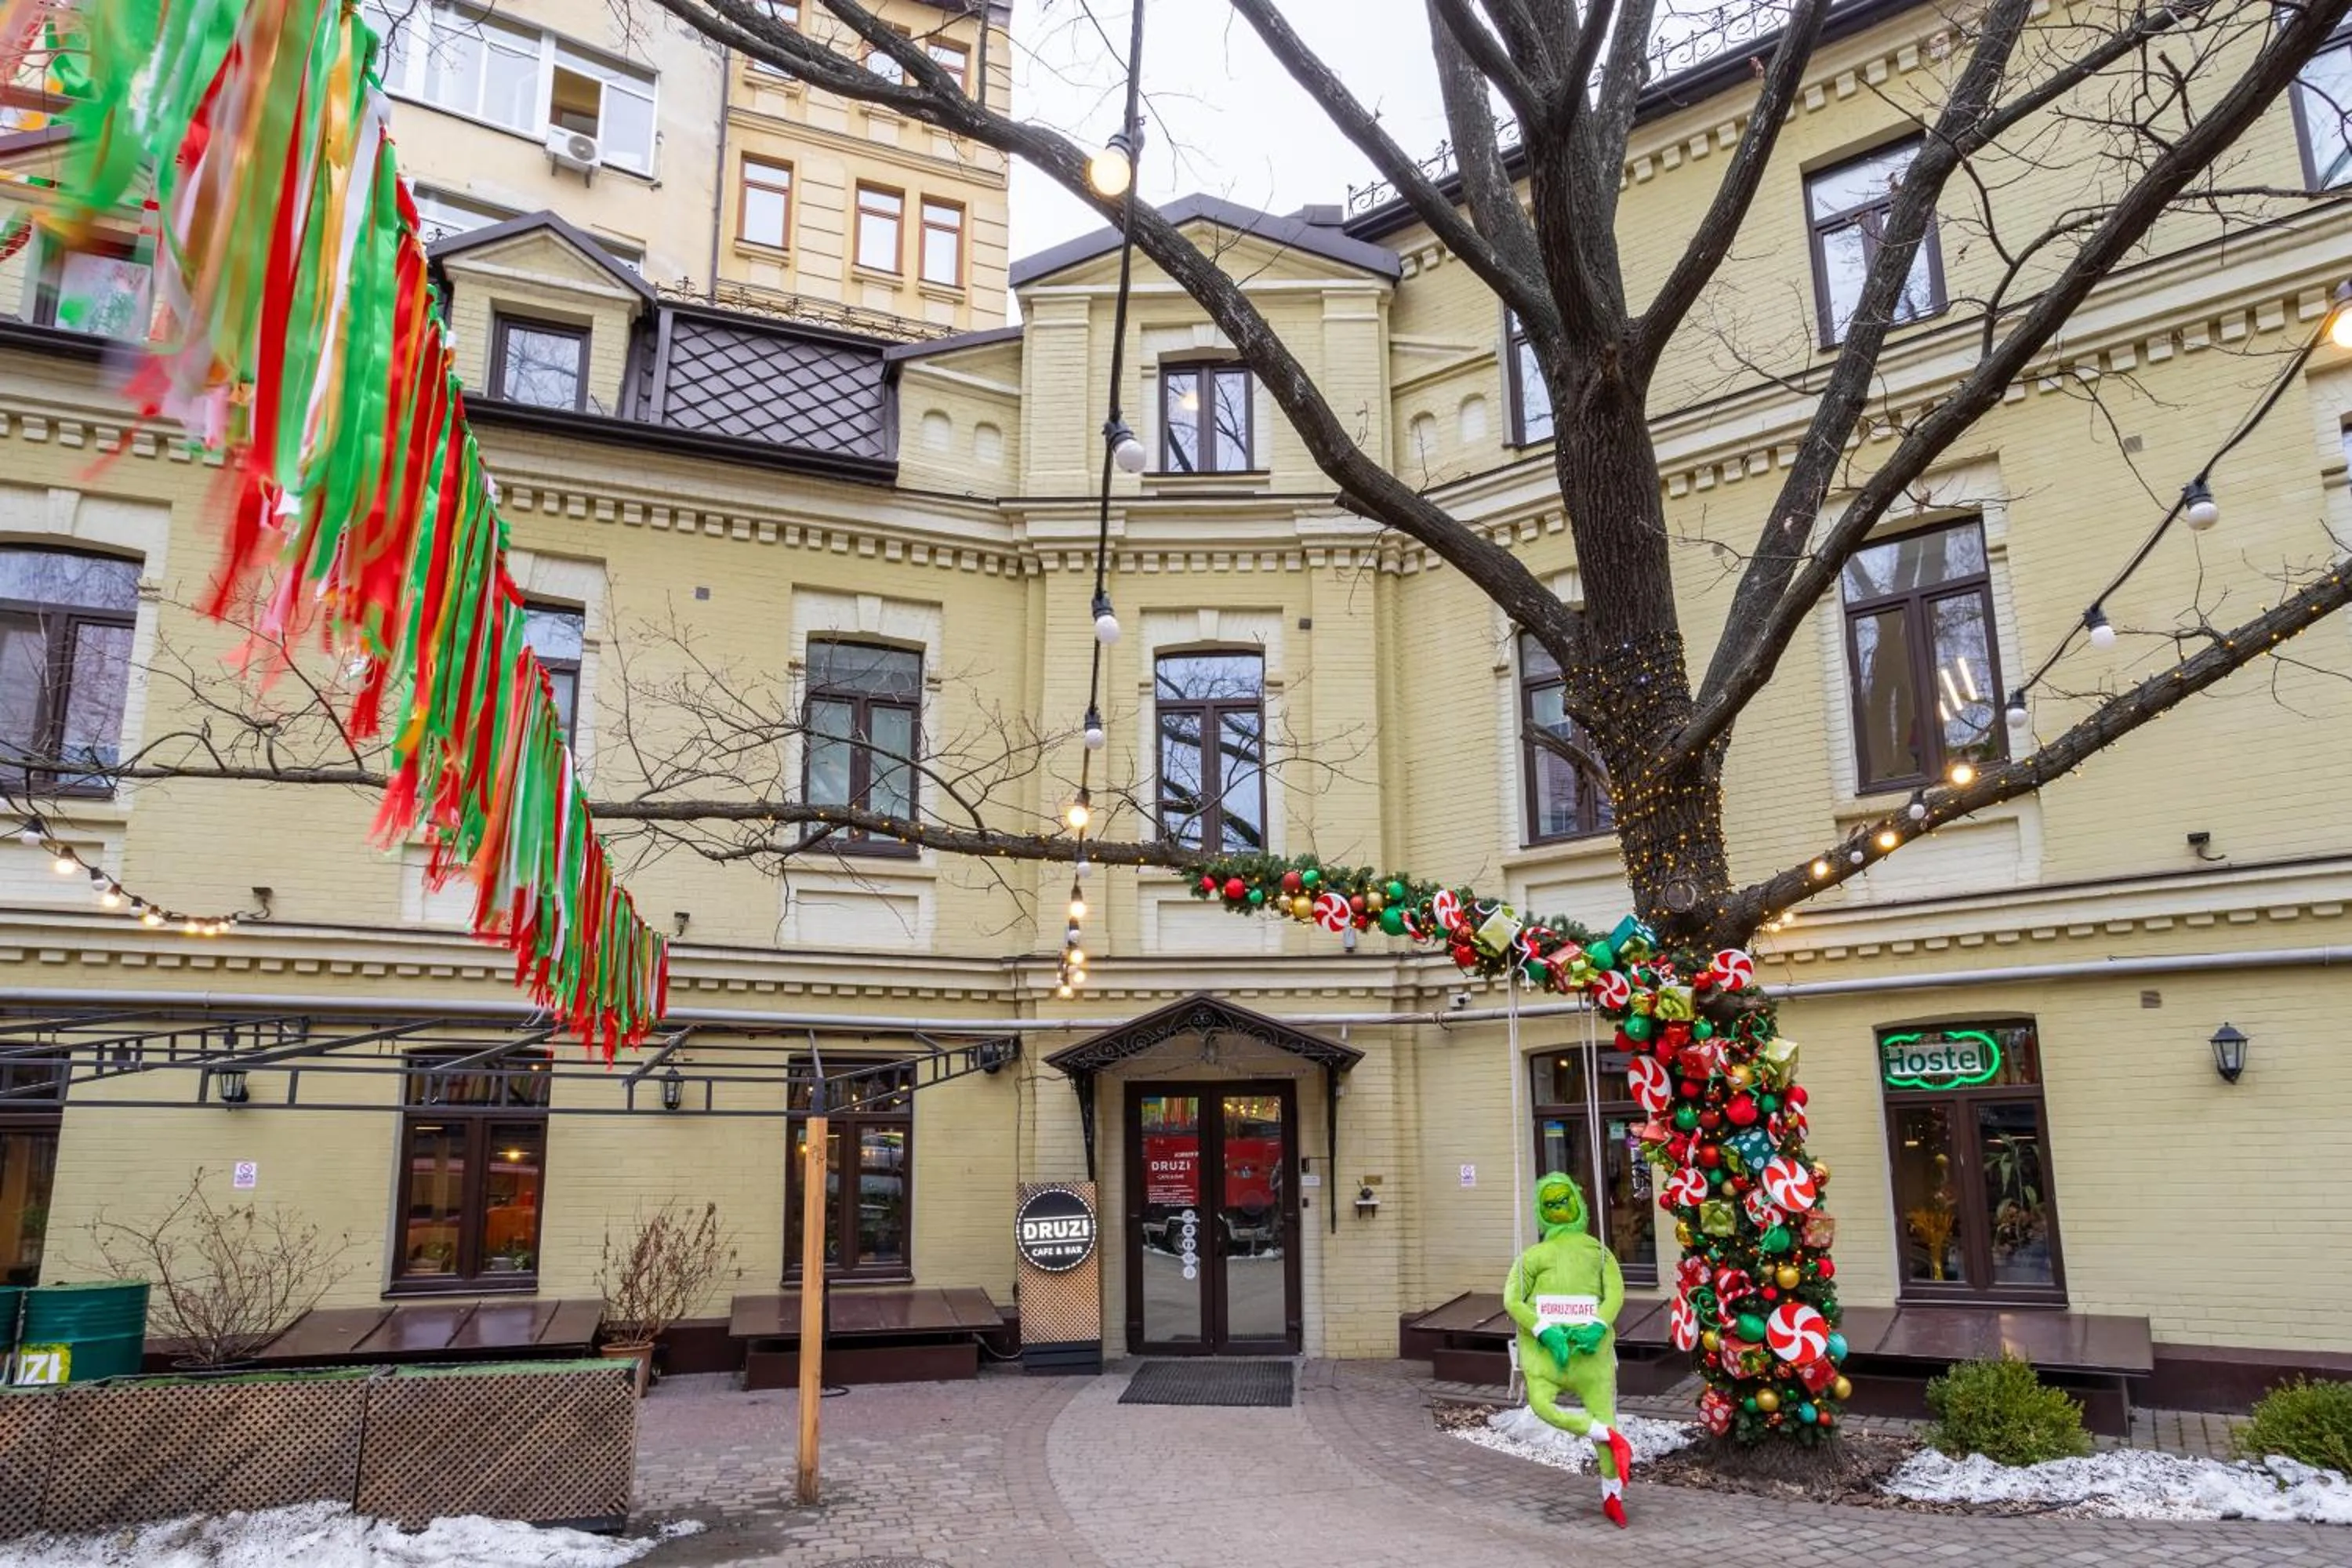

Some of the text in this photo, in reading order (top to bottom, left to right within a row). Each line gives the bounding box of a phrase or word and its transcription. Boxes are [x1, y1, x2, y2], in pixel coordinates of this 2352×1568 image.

[1885, 1044, 1986, 1074] Hostel
[1152, 1161, 1191, 1171] DRUZI
[1023, 1219, 1089, 1240] DRUZI
[1032, 1247, 1054, 1256] CAFE
[1065, 1246, 1083, 1254] BAR
[1541, 1303, 1595, 1315] #DRUZICAFE
